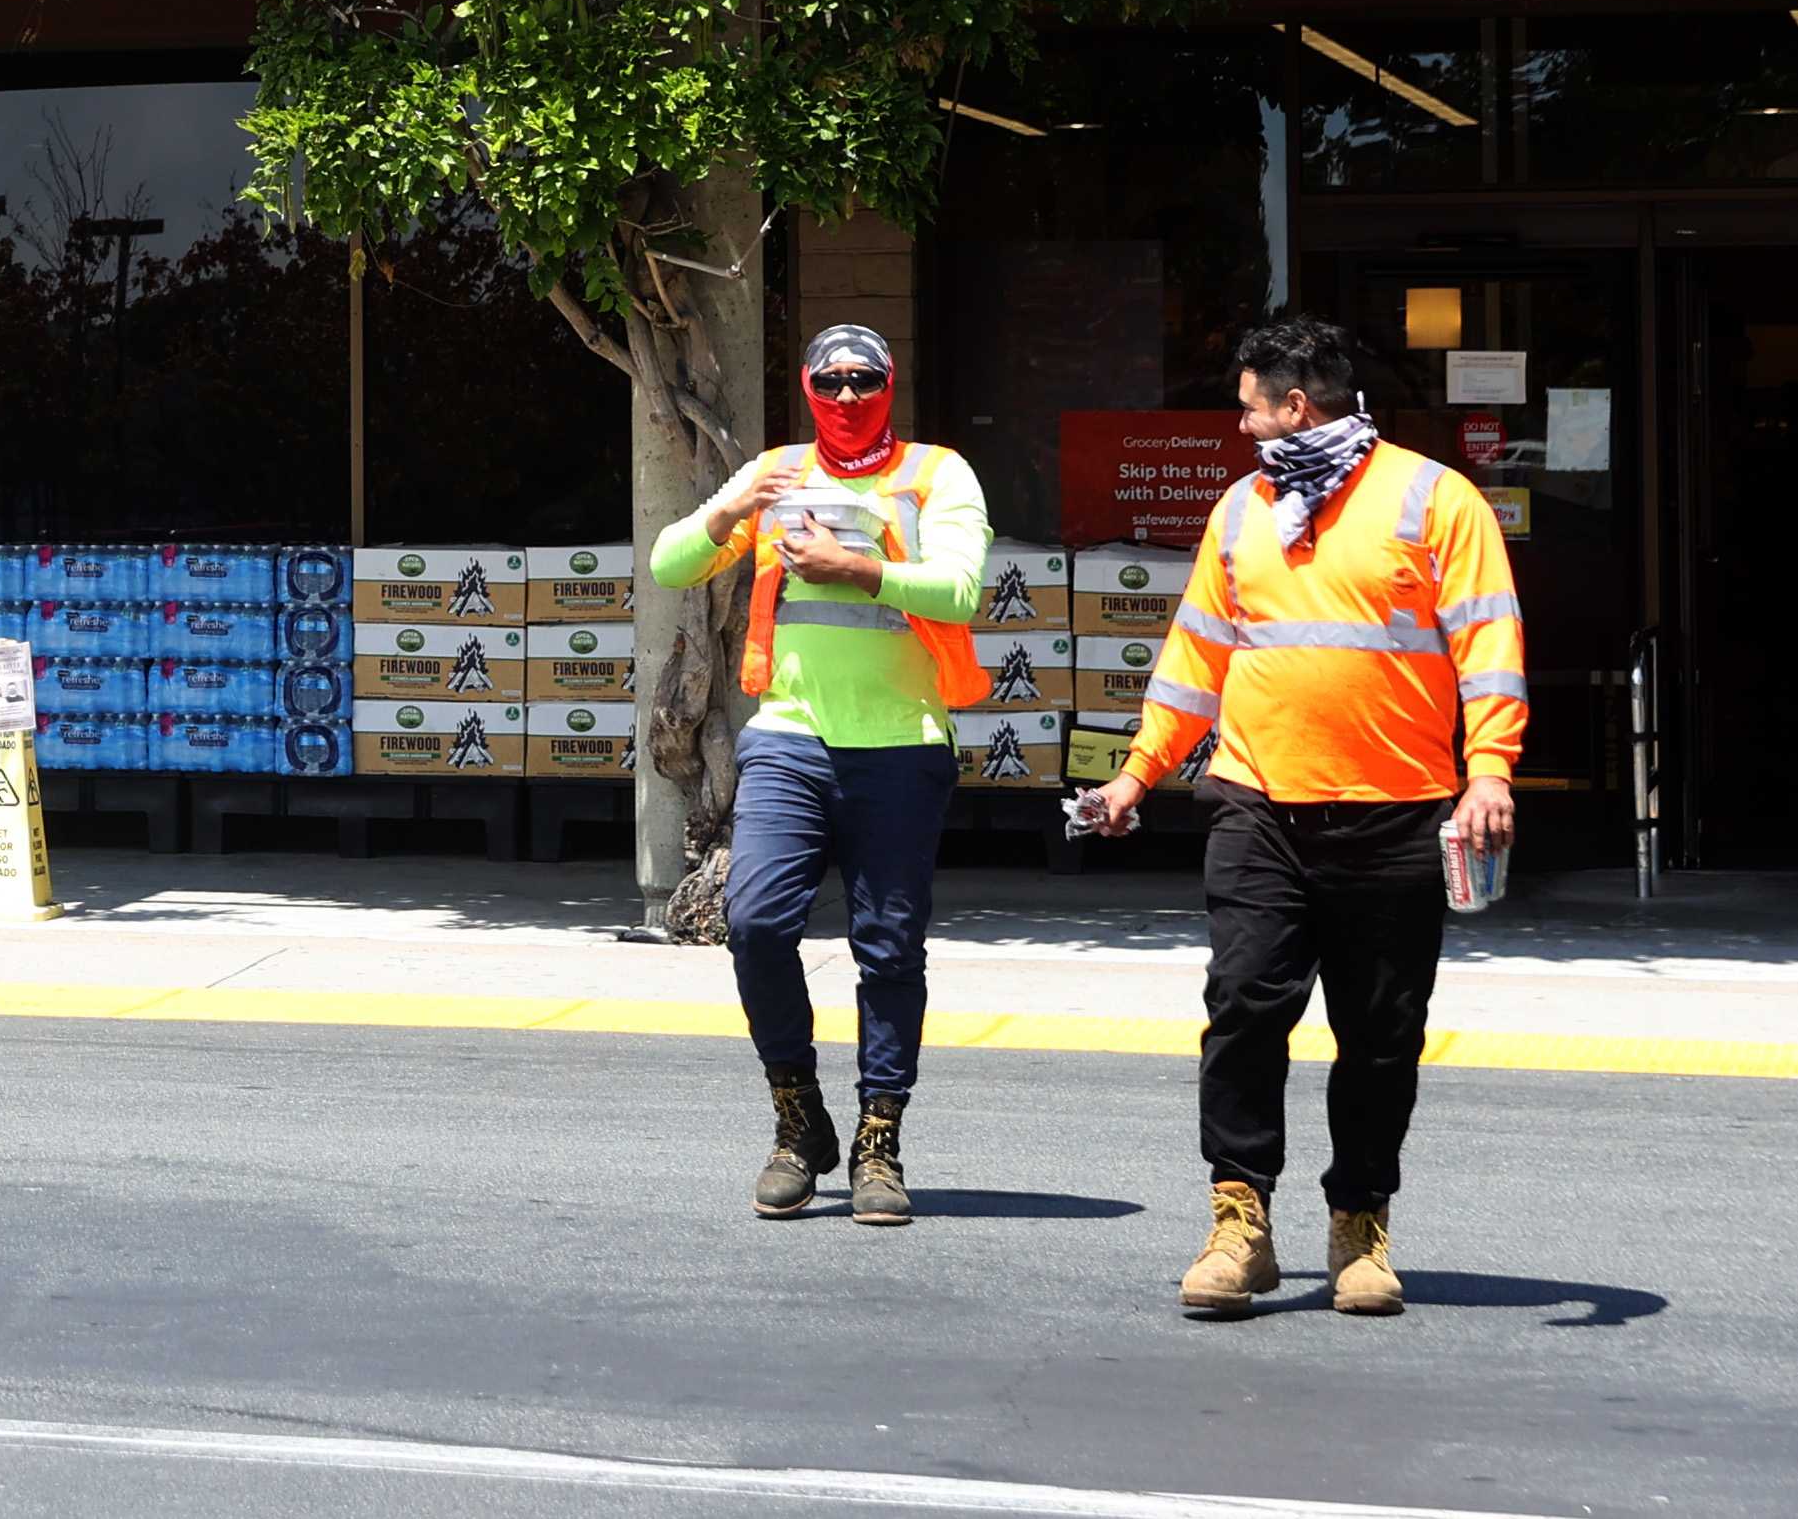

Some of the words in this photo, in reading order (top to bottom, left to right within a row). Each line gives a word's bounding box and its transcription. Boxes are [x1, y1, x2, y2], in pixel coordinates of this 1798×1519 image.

[1464, 422, 1479, 432] DO
[1480, 422, 1500, 432] NOT
[1123, 436, 1222, 451] GroceryDelivery
[1465, 442, 1500, 452] ENTER
[1119, 463, 1157, 481] Skip
[1161, 463, 1191, 479] the
[1196, 463, 1228, 481] trip
[1114, 485, 1154, 501] with
[1159, 485, 1227, 501] Deliver
[381, 584, 442, 599] FIREWOOD
[553, 582, 615, 597] FIREWOOD
[1101, 596, 1167, 612] FIREWOOD
[379, 659, 440, 675] FIREWOOD
[553, 662, 614, 676] FIREWOOD
[1104, 673, 1152, 690] FIREW
[380, 736, 441, 751] FIREWOOD
[550, 739, 613, 754] FIREWOOD
